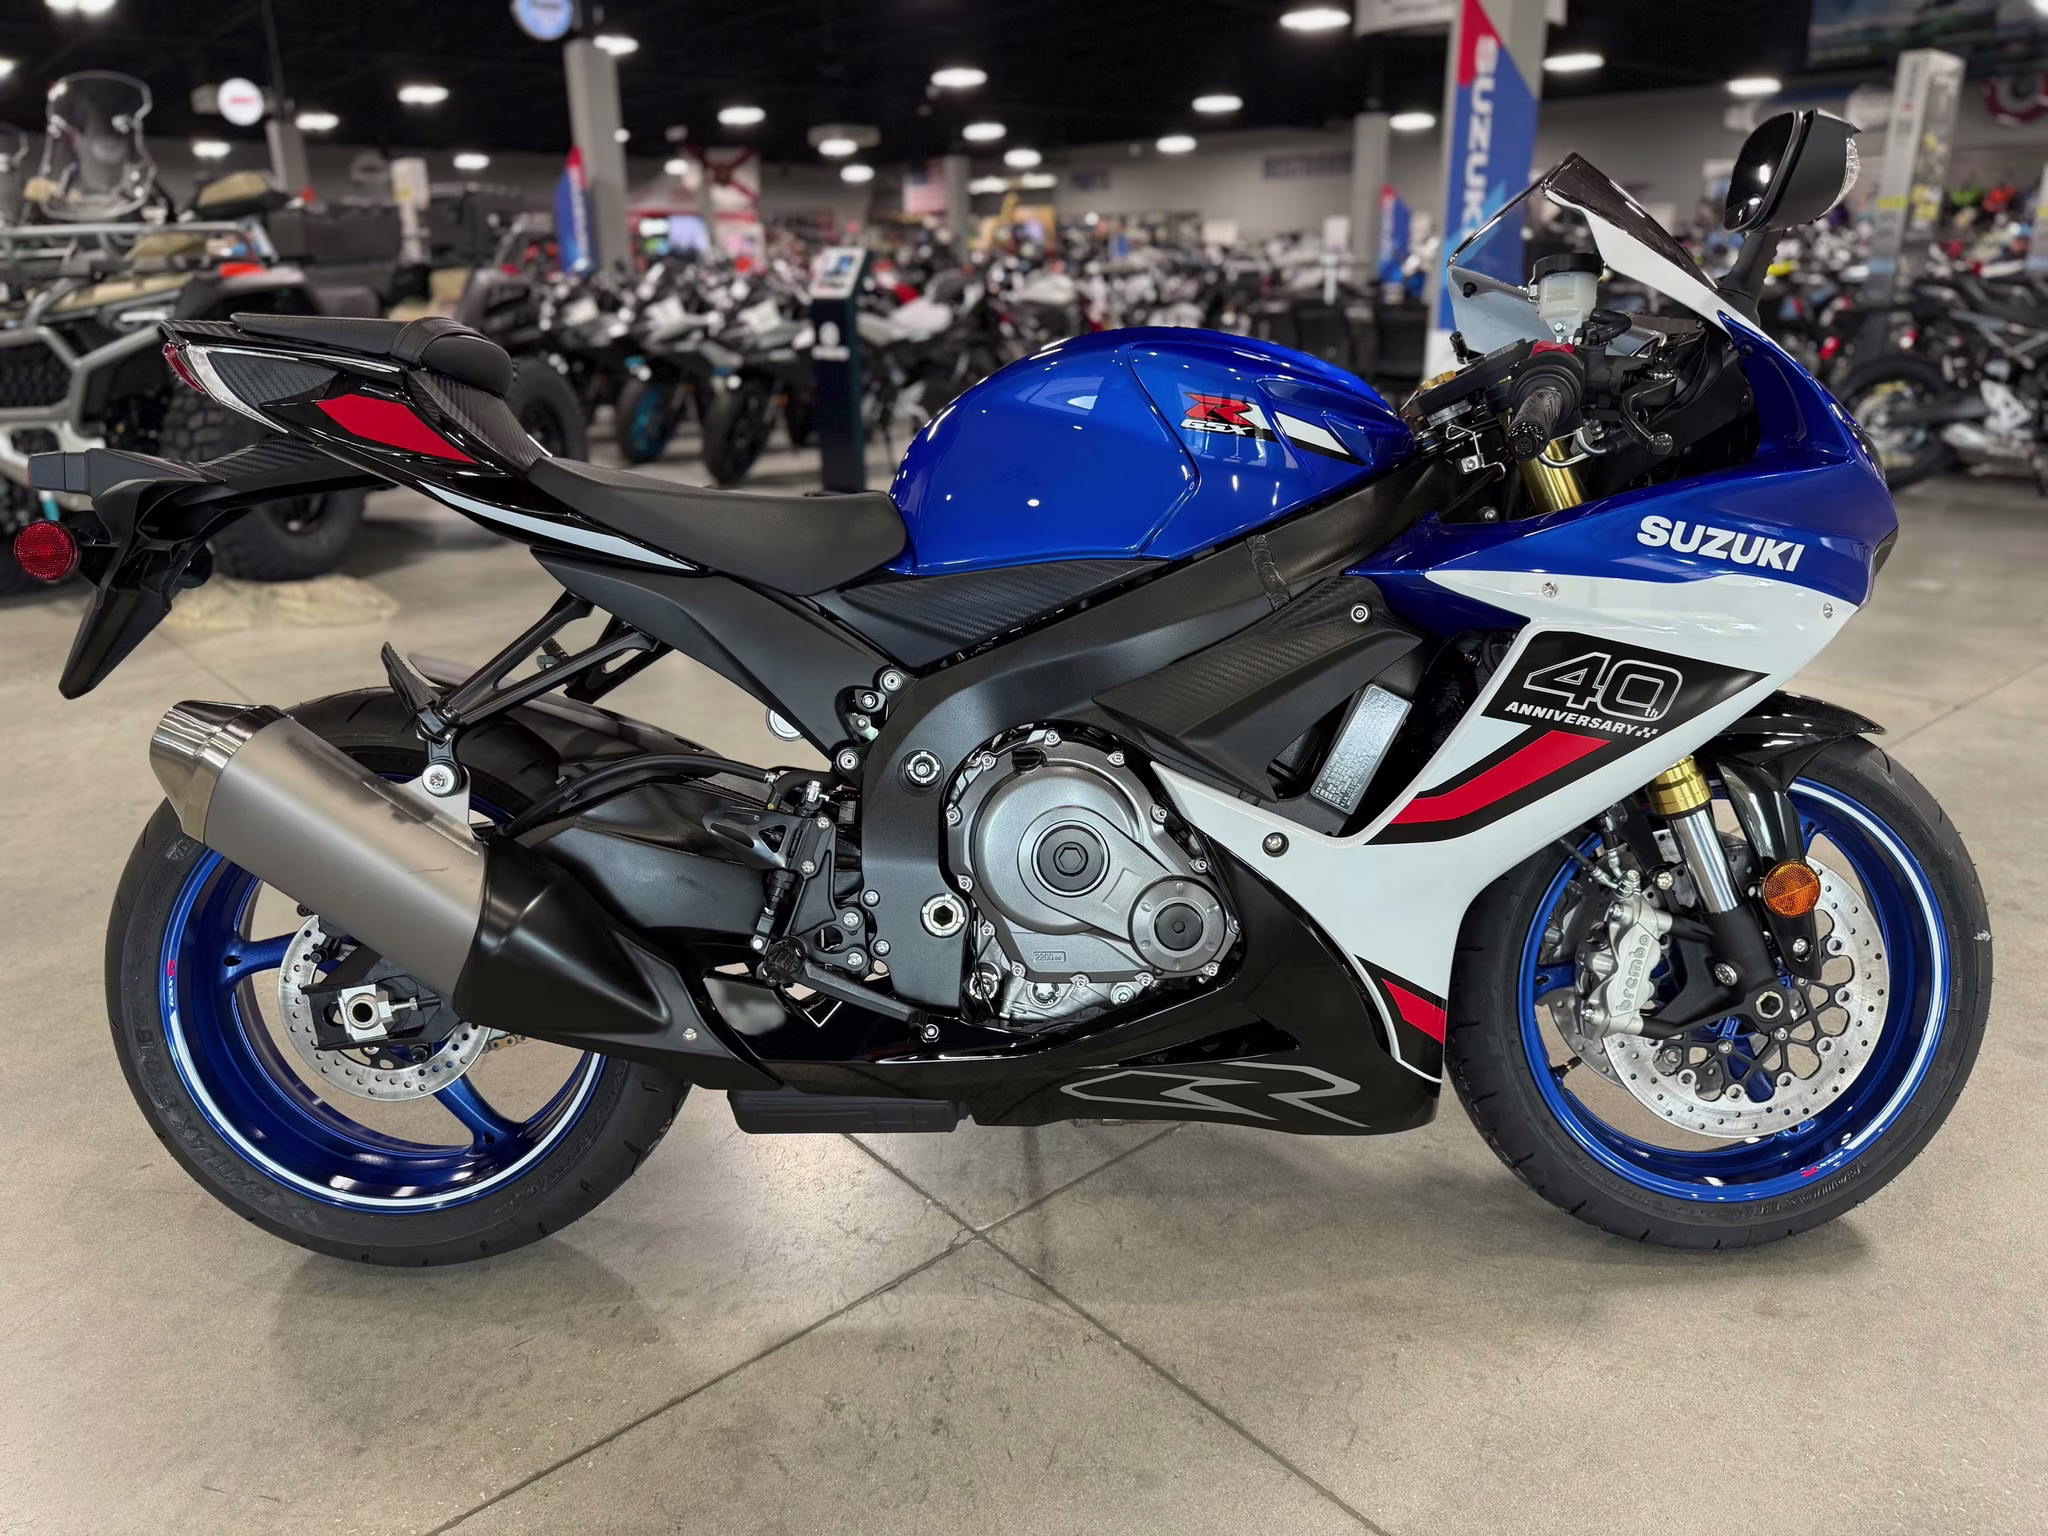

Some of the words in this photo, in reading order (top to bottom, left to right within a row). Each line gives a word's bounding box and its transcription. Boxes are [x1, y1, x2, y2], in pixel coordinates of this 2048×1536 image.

[1180, 418, 1255, 436] GSX
[1636, 514, 1806, 573] SUZUKI
[1504, 701, 1639, 737] ANNIVERSARY
[1034, 953, 1054, 962] 2200
[1615, 934, 1652, 1012] brembo
